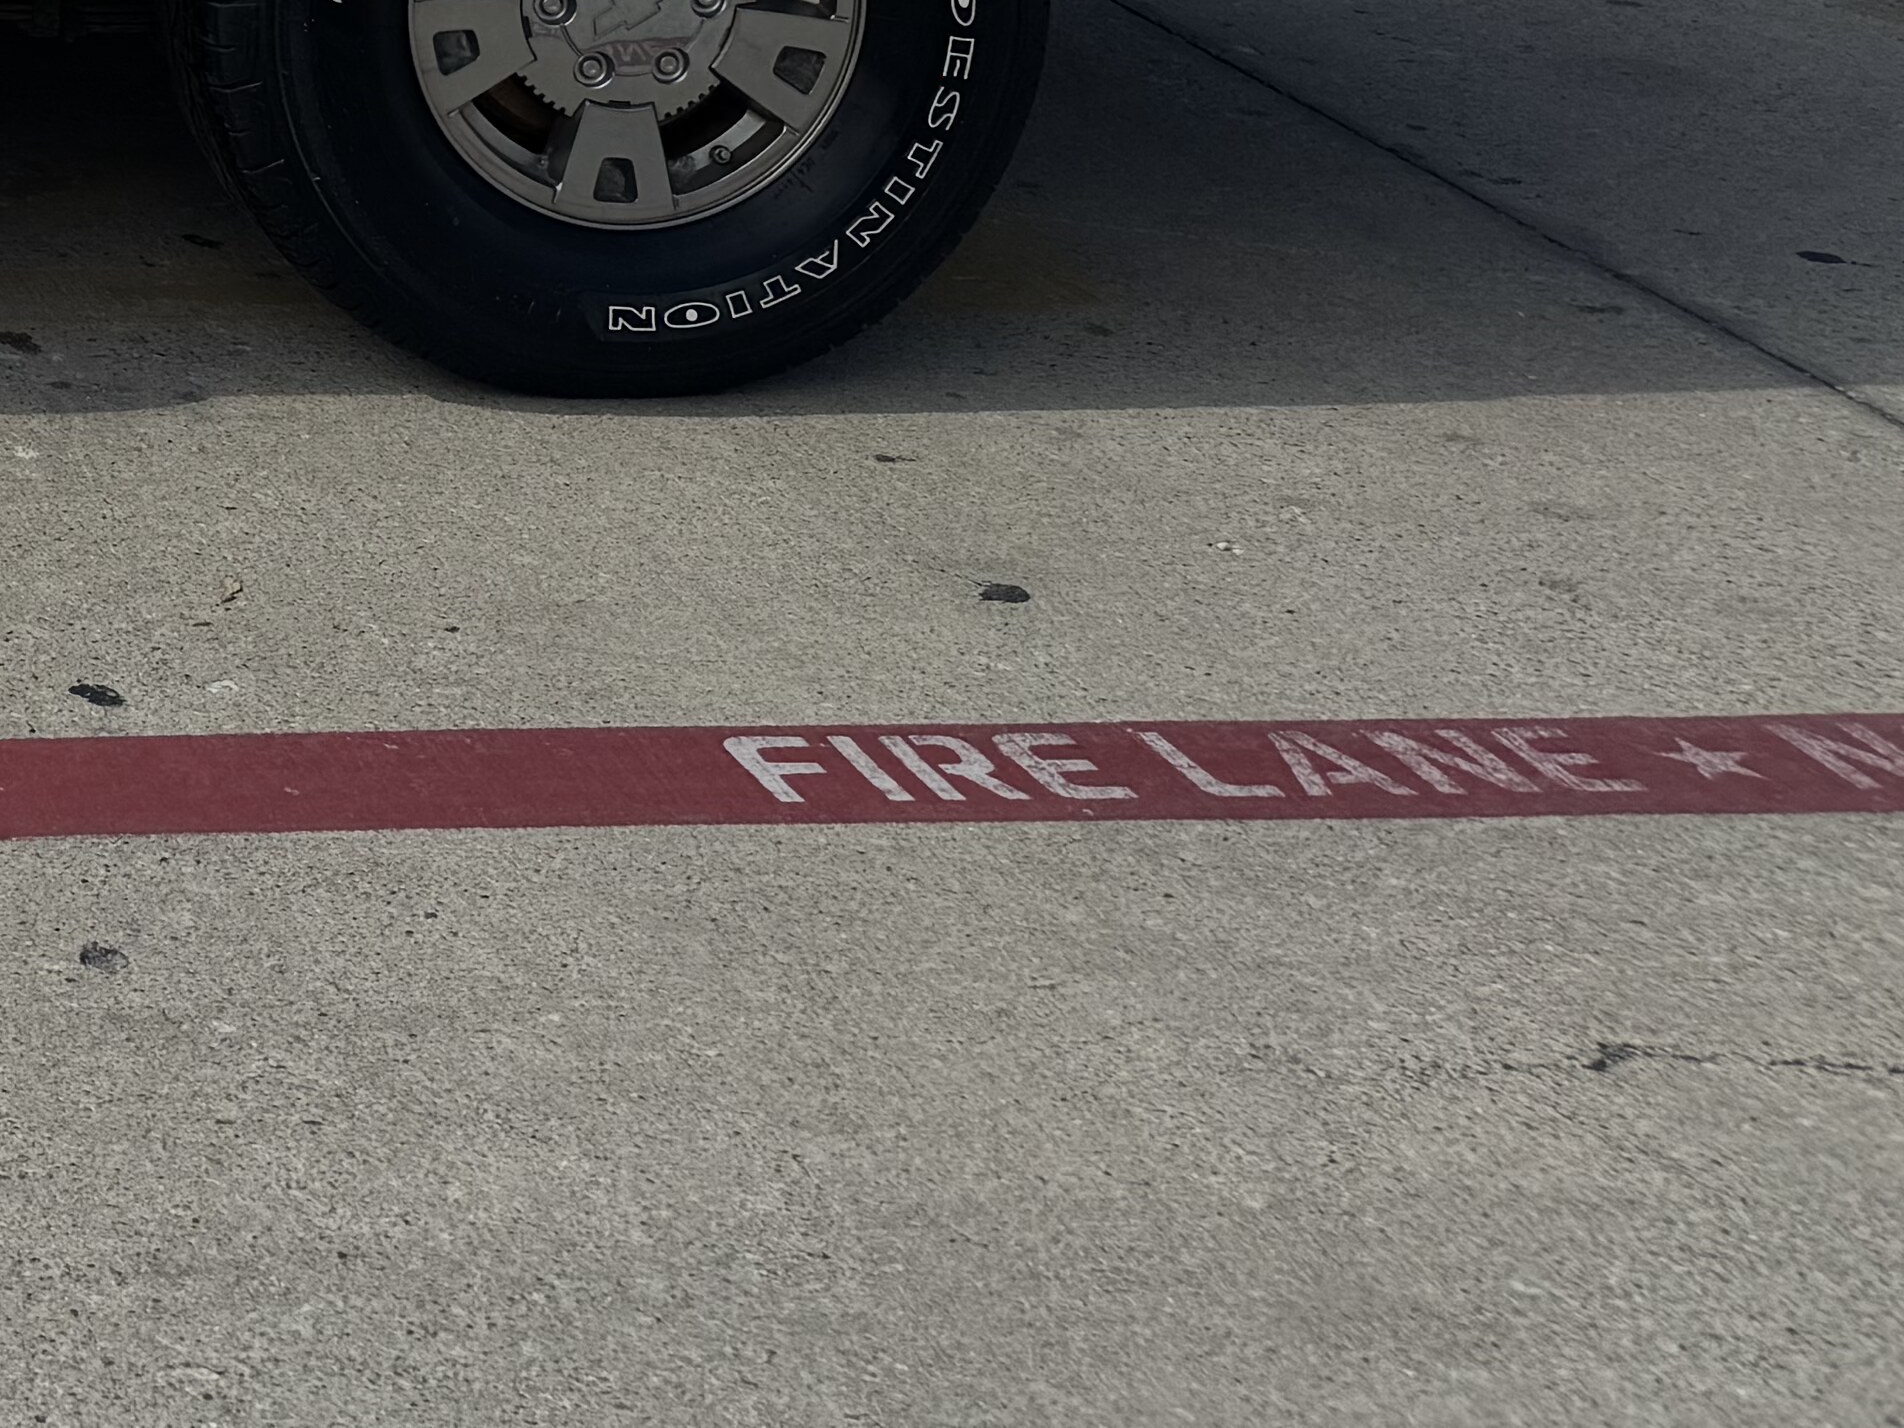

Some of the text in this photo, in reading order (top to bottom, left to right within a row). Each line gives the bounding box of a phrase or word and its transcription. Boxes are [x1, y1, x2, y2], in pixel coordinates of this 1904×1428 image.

[721, 722, 1904, 804] FIRE LANE N
